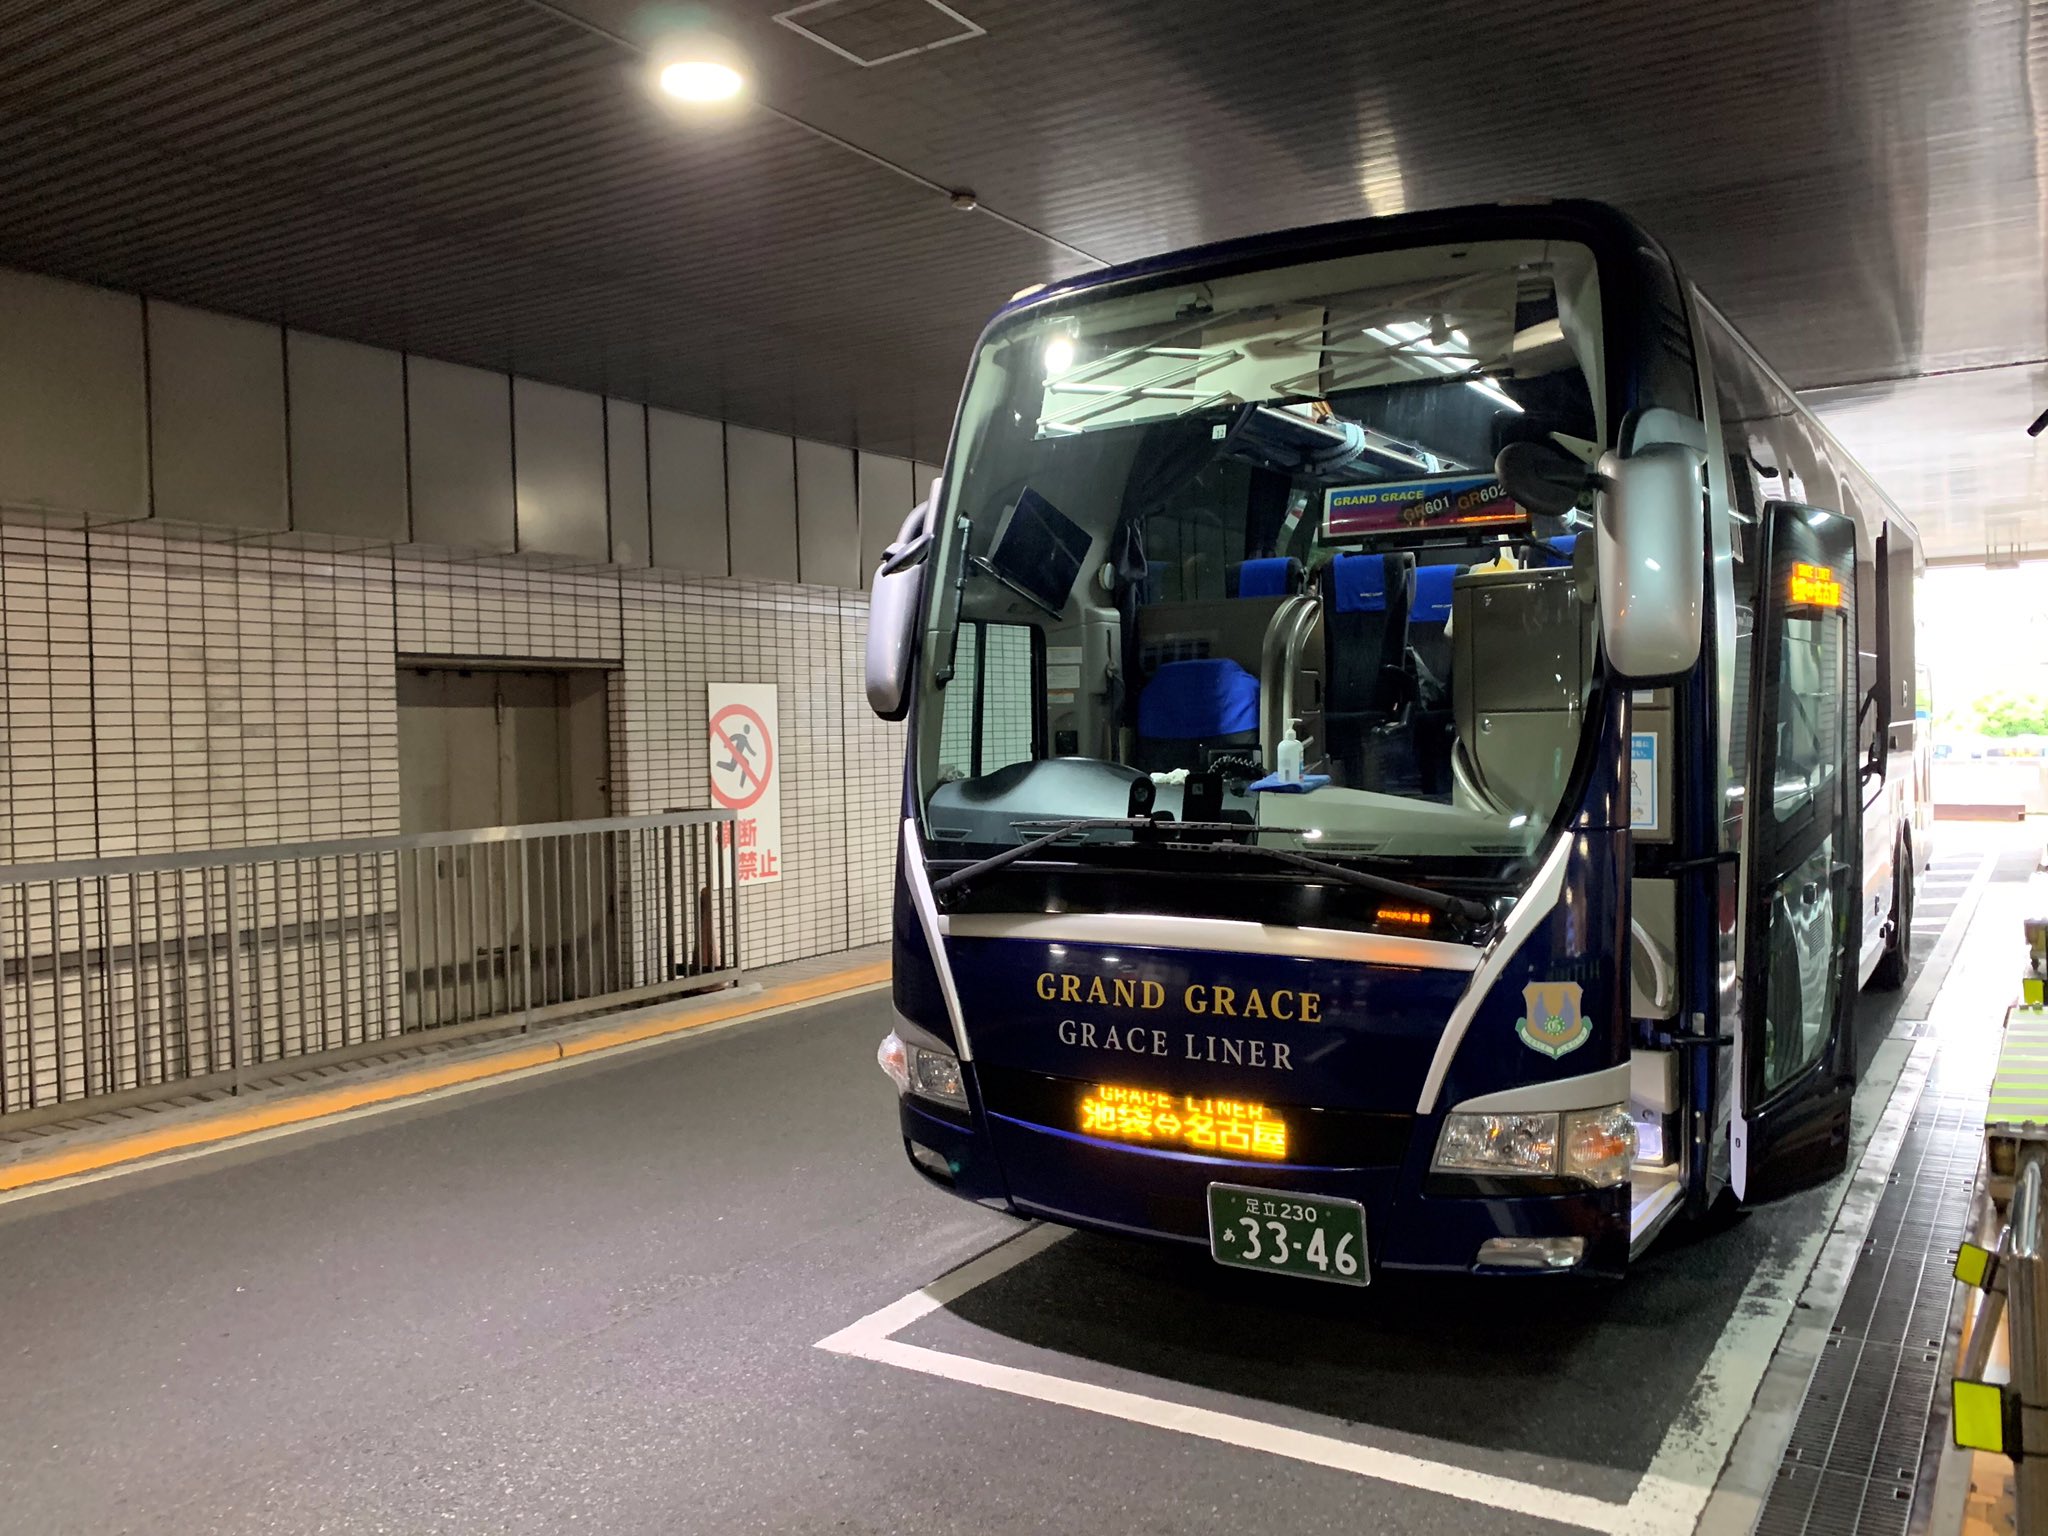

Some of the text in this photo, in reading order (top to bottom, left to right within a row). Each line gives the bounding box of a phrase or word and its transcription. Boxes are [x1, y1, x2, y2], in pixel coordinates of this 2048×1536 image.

[1333, 490, 1425, 507] GRAND GRACE
[1403, 495, 1450, 521] GR601
[1458, 484, 1507, 510] GR602
[736, 849, 778, 880] 禁止
[1036, 972, 1322, 1023] GRAND GRACE
[1058, 1019, 1294, 1070] GRACE LINER
[1222, 1217, 1358, 1276] あ 33-46
